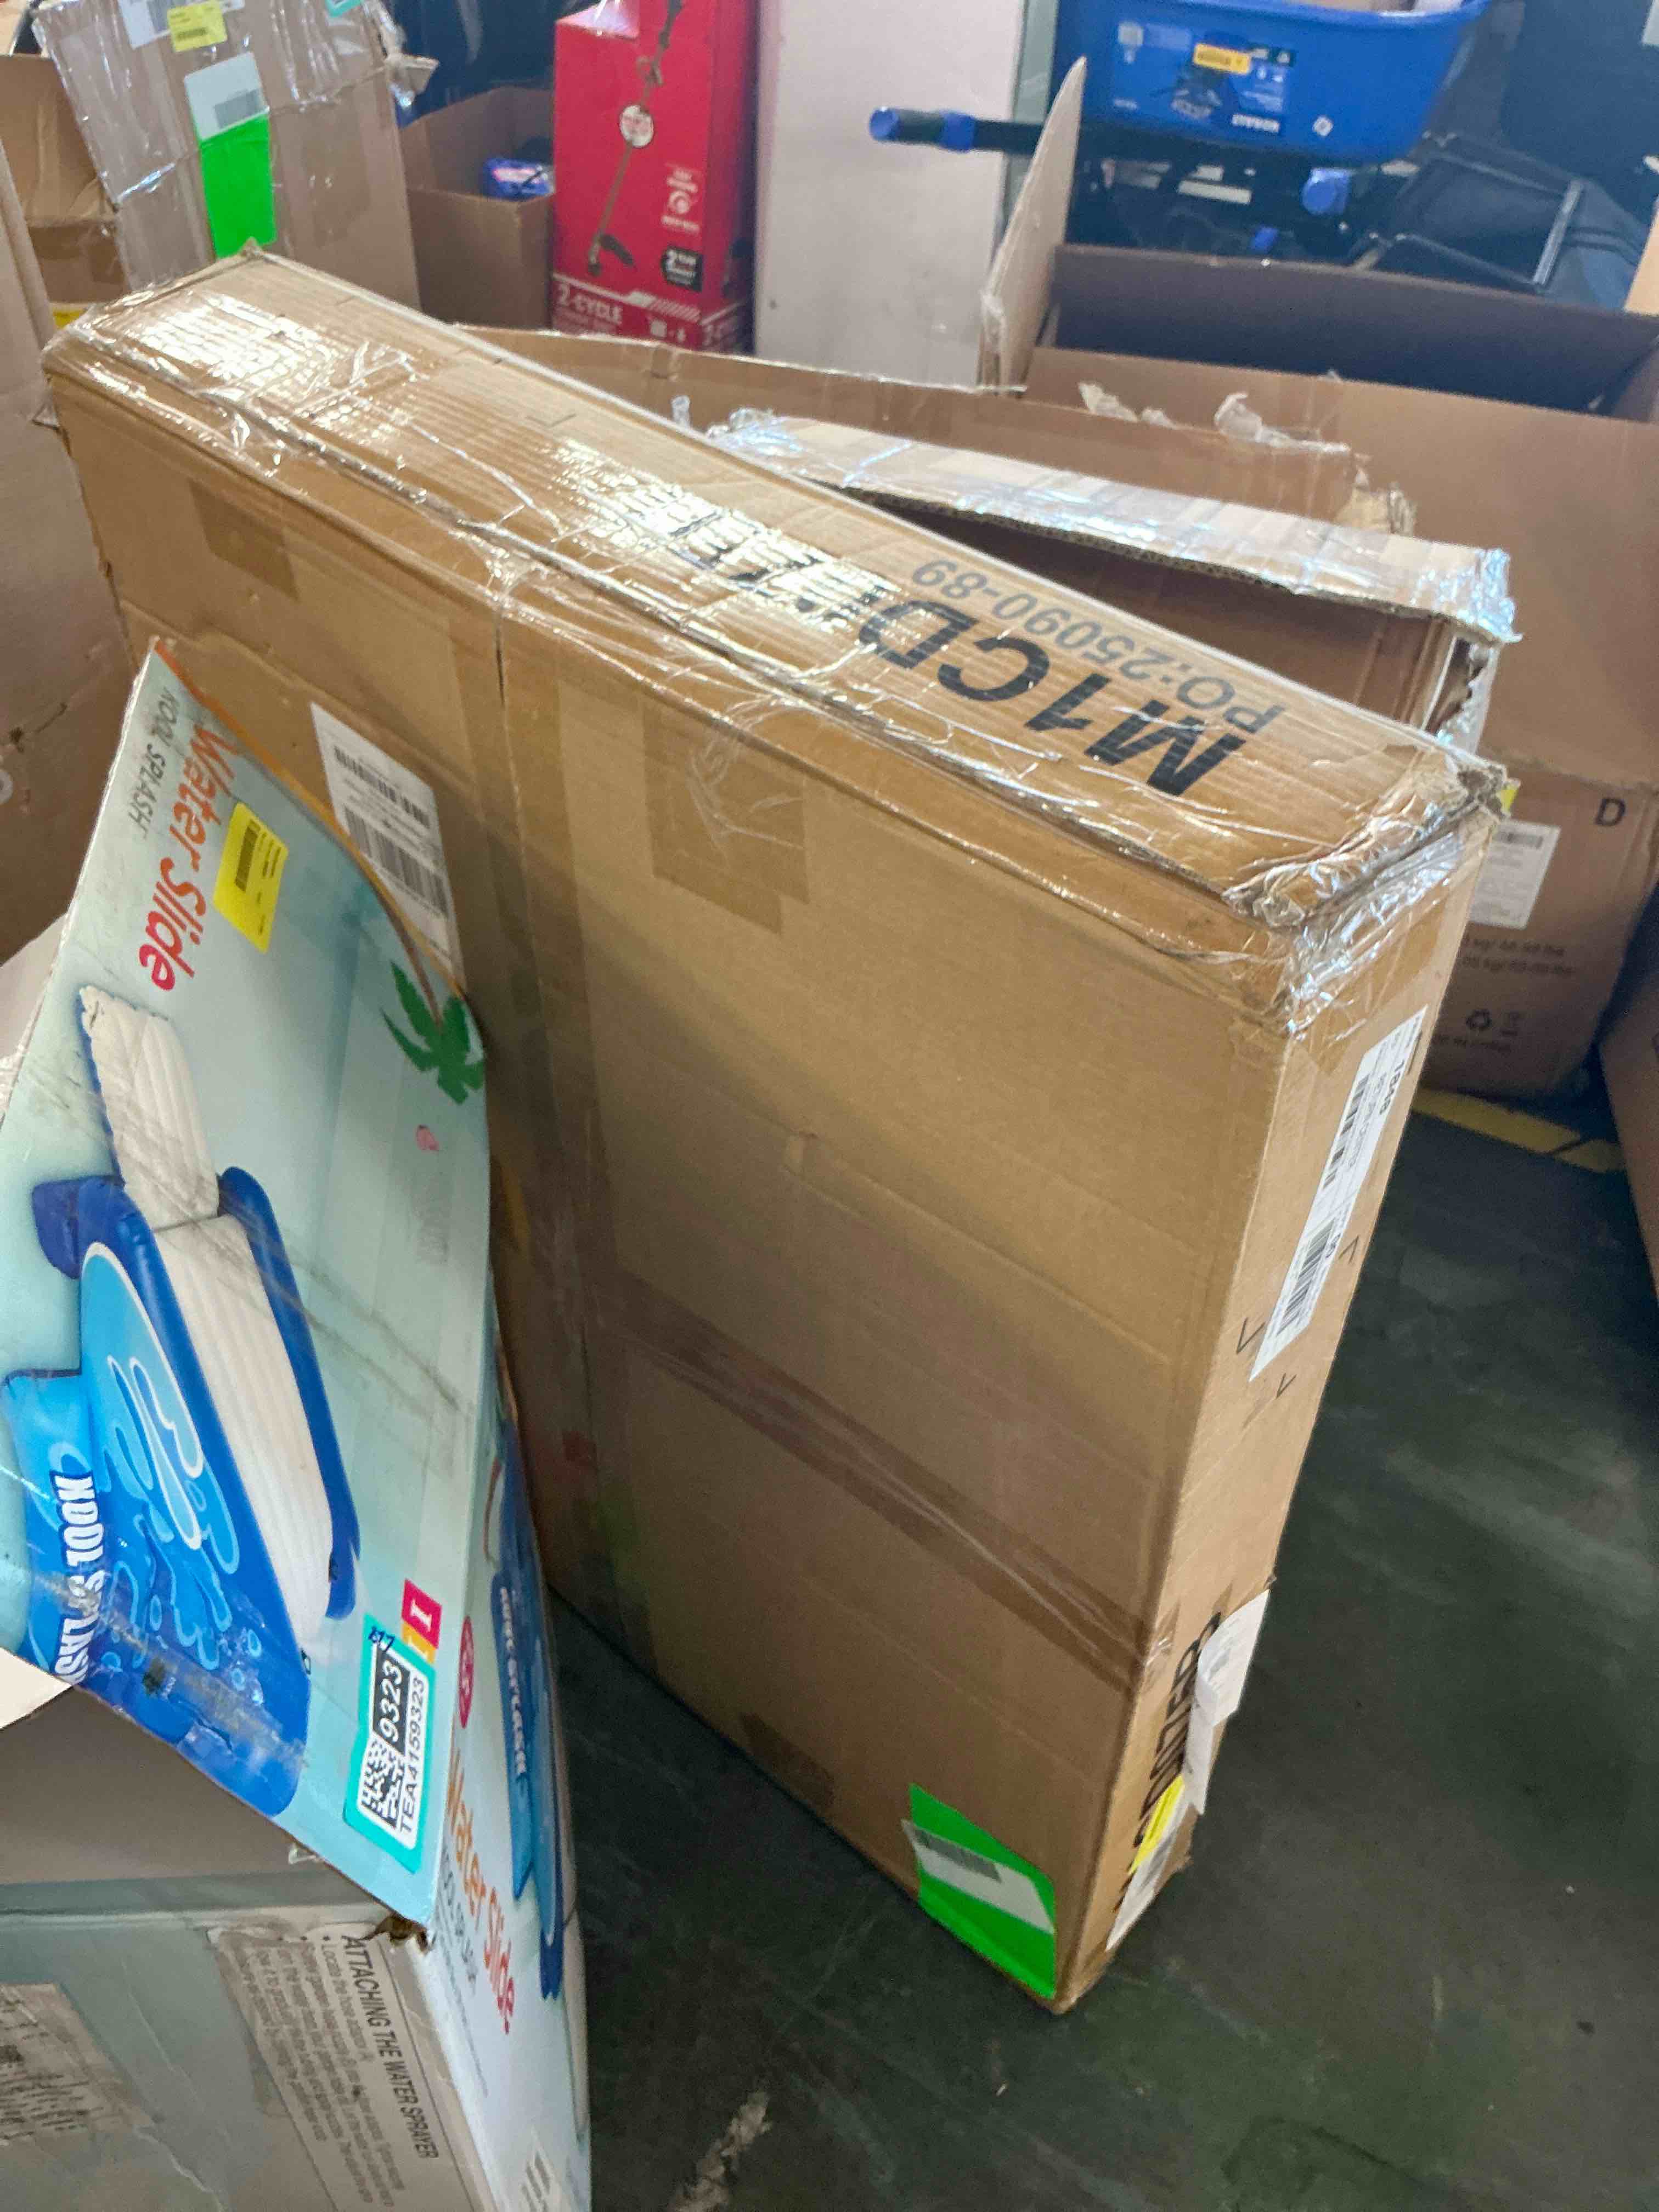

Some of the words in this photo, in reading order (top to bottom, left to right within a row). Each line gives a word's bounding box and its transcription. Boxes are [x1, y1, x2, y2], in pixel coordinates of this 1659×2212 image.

[128, 744, 166, 839] SPLASH
[169, 722, 240, 872] Water
[1595, 798, 1626, 827] D
[138, 857, 206, 991] Slide
[55, 1474, 104, 1567] KOOL
[380, 1658, 403, 1743] 9323
[399, 1676, 427, 1833] TEA4159323
[342, 1934, 391, 2029] ATTACHING
[373, 2029, 403, 2059] THE
[383, 2058, 419, 2112] WATER
[400, 2106, 439, 2159] SPRAYER
